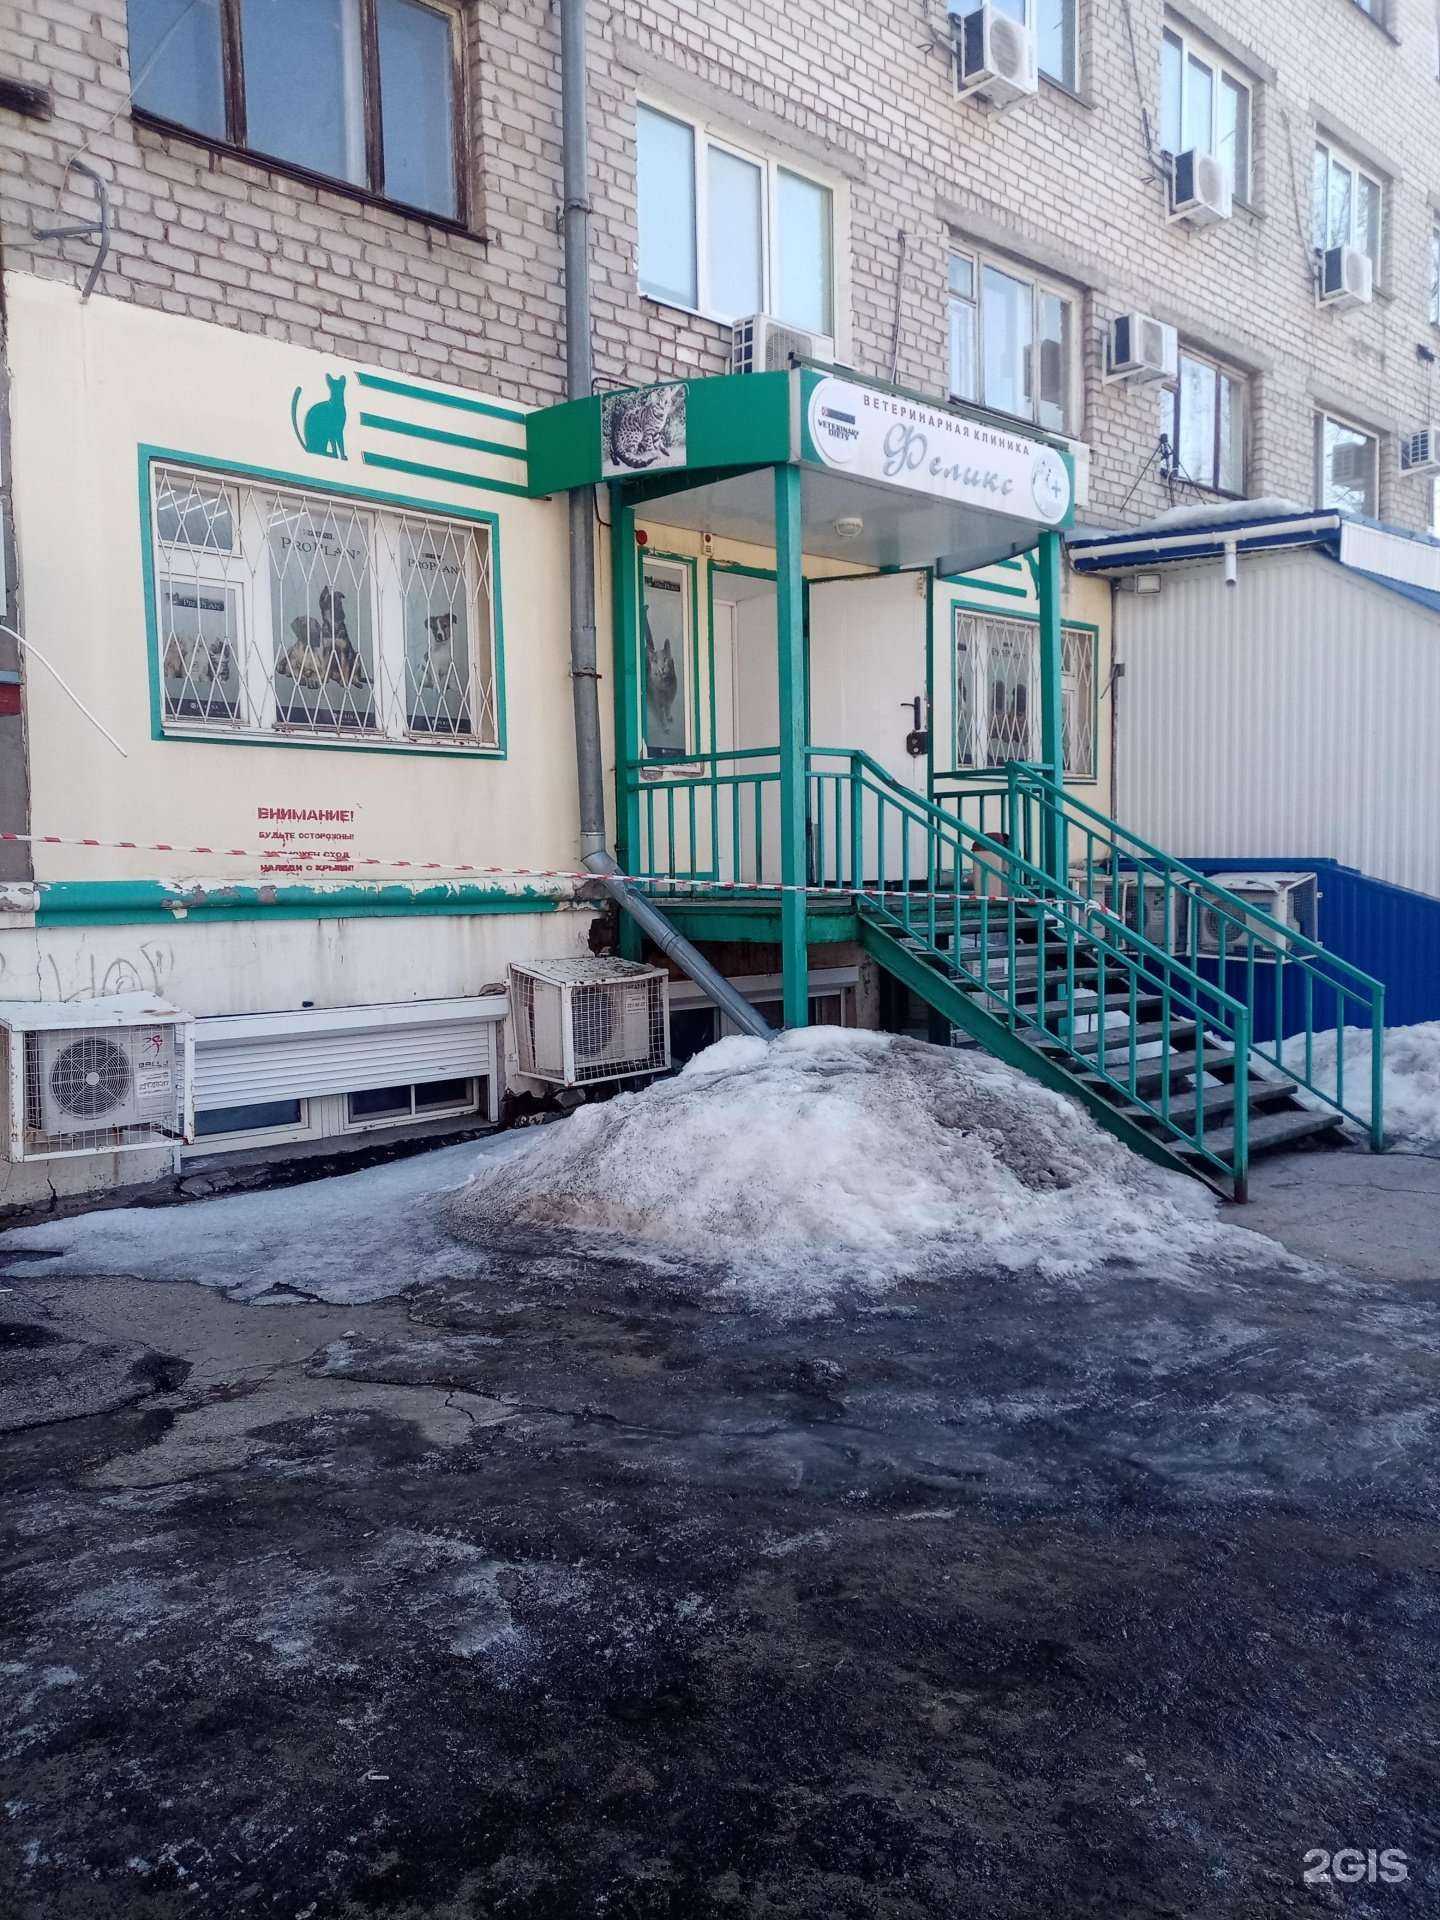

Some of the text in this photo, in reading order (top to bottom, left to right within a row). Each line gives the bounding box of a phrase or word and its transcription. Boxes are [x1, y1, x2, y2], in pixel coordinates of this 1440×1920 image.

[863, 394, 970, 437] ВЕТЕРИНАРНАЯ
[973, 427, 1031, 456] КЛИНИКА
[882, 422, 1014, 497] Феликс
[257, 807, 354, 822] ВНИМАНИЕ!
